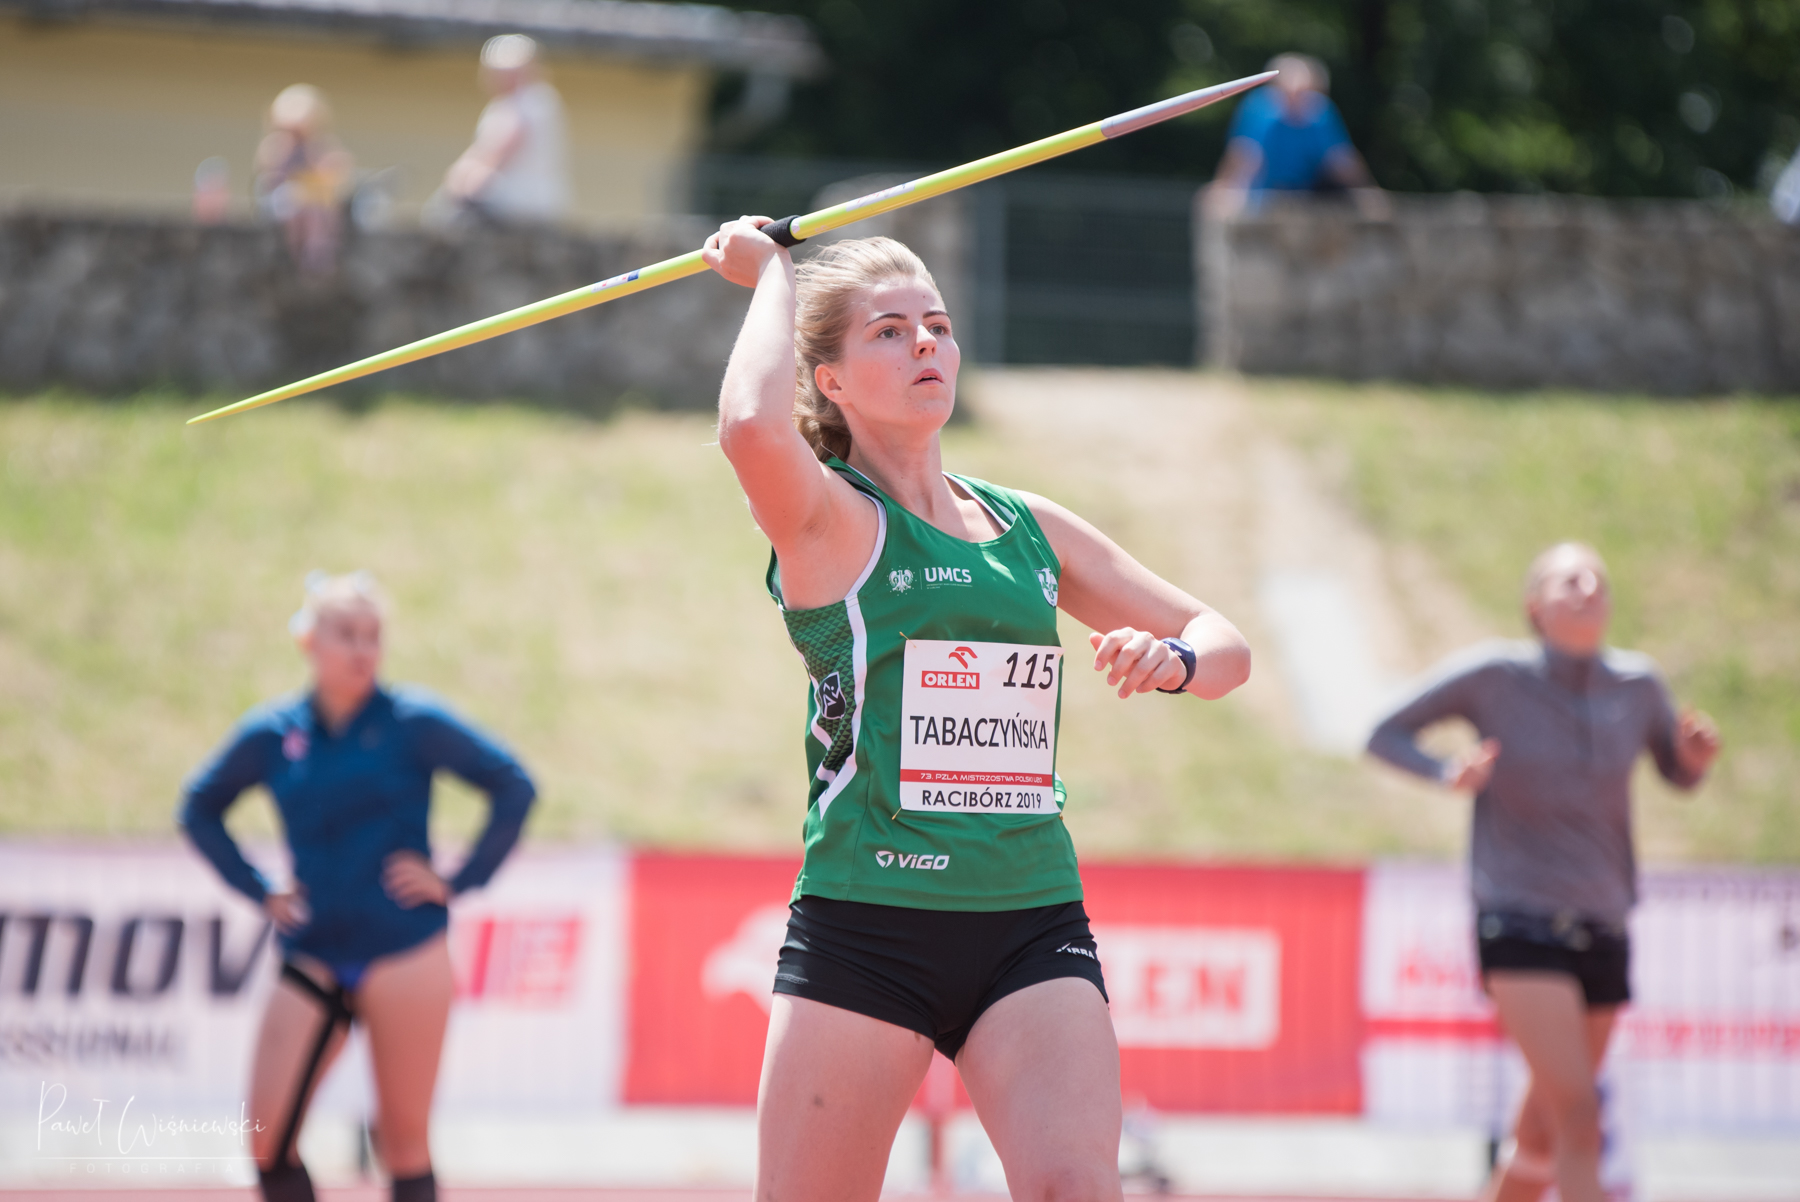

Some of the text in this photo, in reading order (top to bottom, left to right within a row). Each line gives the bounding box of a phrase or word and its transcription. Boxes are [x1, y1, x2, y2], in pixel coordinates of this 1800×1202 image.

[924, 567, 972, 583] UMCS
[924, 673, 977, 688] ORLEN
[1003, 652, 1055, 690] 115
[909, 712, 1049, 750] TABACZYŃSKA
[922, 787, 1042, 809] RACIBÓRZ 2019
